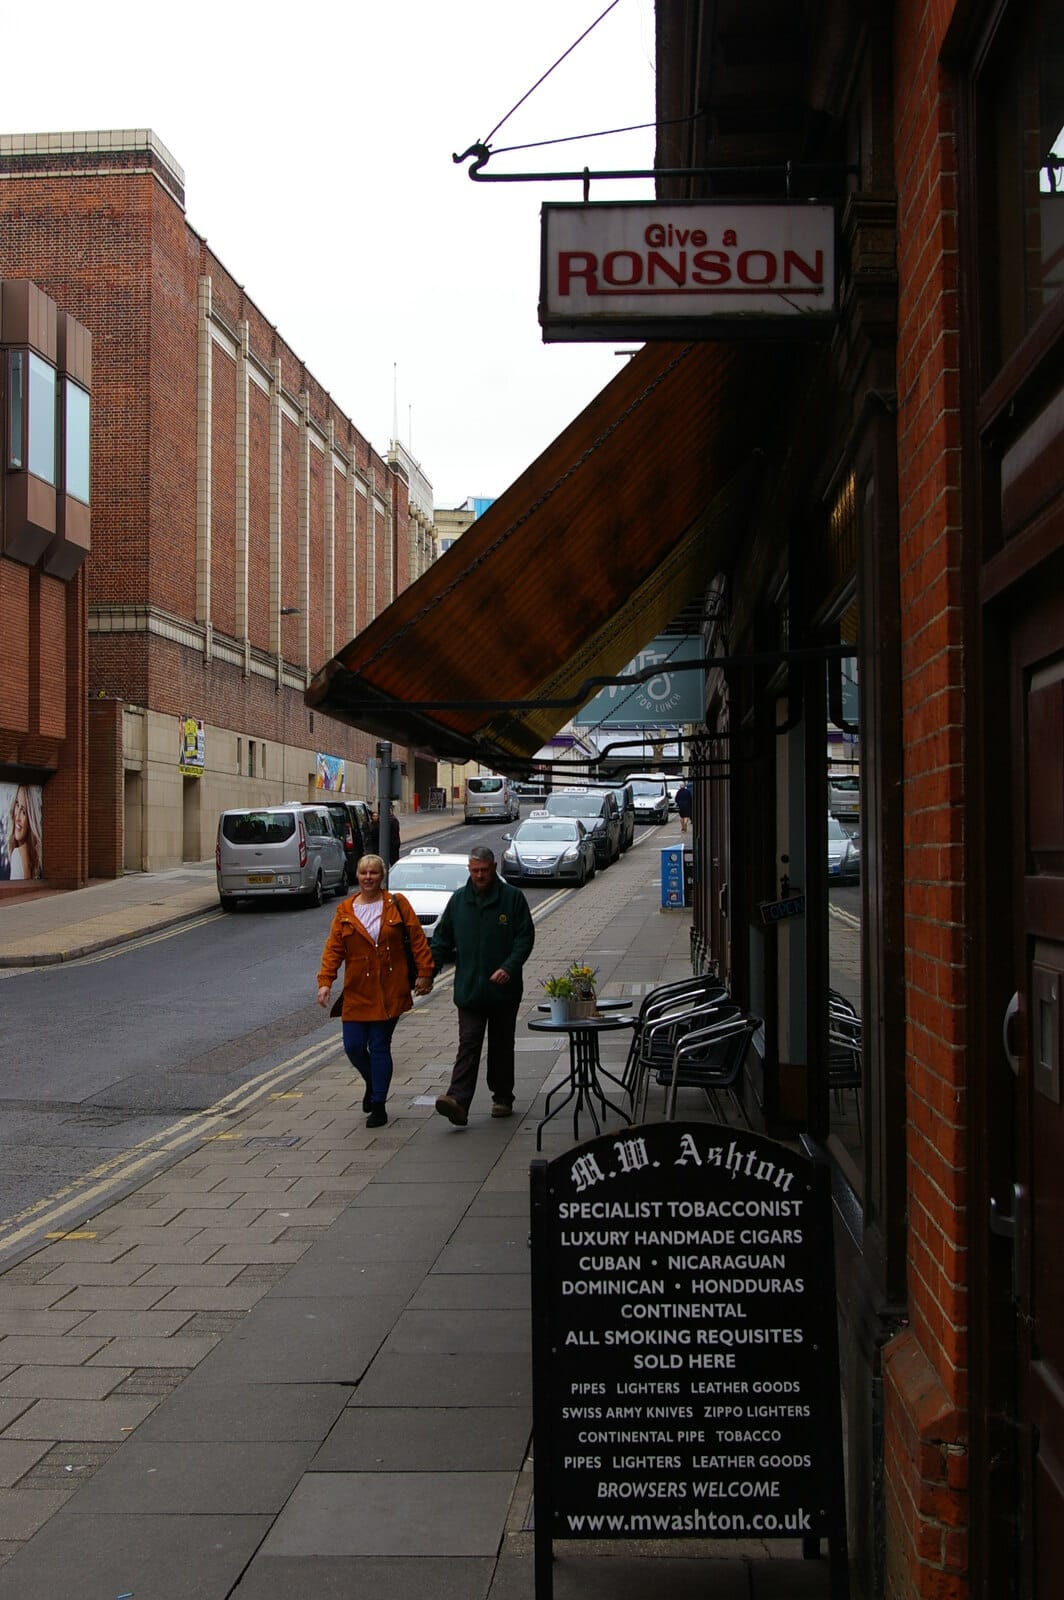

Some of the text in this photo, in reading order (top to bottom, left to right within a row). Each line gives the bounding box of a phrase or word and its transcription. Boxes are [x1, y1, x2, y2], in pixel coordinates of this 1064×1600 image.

[645, 223, 738, 248] Give a
[558, 249, 823, 297] RONSON
[636, 693, 681, 713] FOR LUNCH
[674, 1133, 795, 1193] Ashton
[558, 1200, 803, 1219] SPECIALIST TOBACCONIST
[561, 1229, 803, 1246] LUXURY HANDMADE CIGARS
[579, 1254, 785, 1271] CUBAN NICARAGUAN
[562, 1278, 804, 1295] DOMINICAN HONDDURAS
[620, 1303, 747, 1319] CONTINENTAL
[565, 1328, 803, 1347] ALL SMOKING REQUISITES
[633, 1353, 736, 1369] SOLD HERE
[571, 1381, 800, 1394] PIPES LIGHTERS LEATHER GOODS
[562, 1405, 810, 1419] SWISS ARMY KNIVES ZIPPO LIGHTERS
[578, 1430, 781, 1443] CONTINENTAL PIPE TOBACCO
[564, 1454, 811, 1469] PIPES LIGHTERS LEATHER GOODS
[597, 1481, 780, 1498] BROWSERS WELCOME
[567, 1508, 811, 1531] www.mwashton.co.uk
